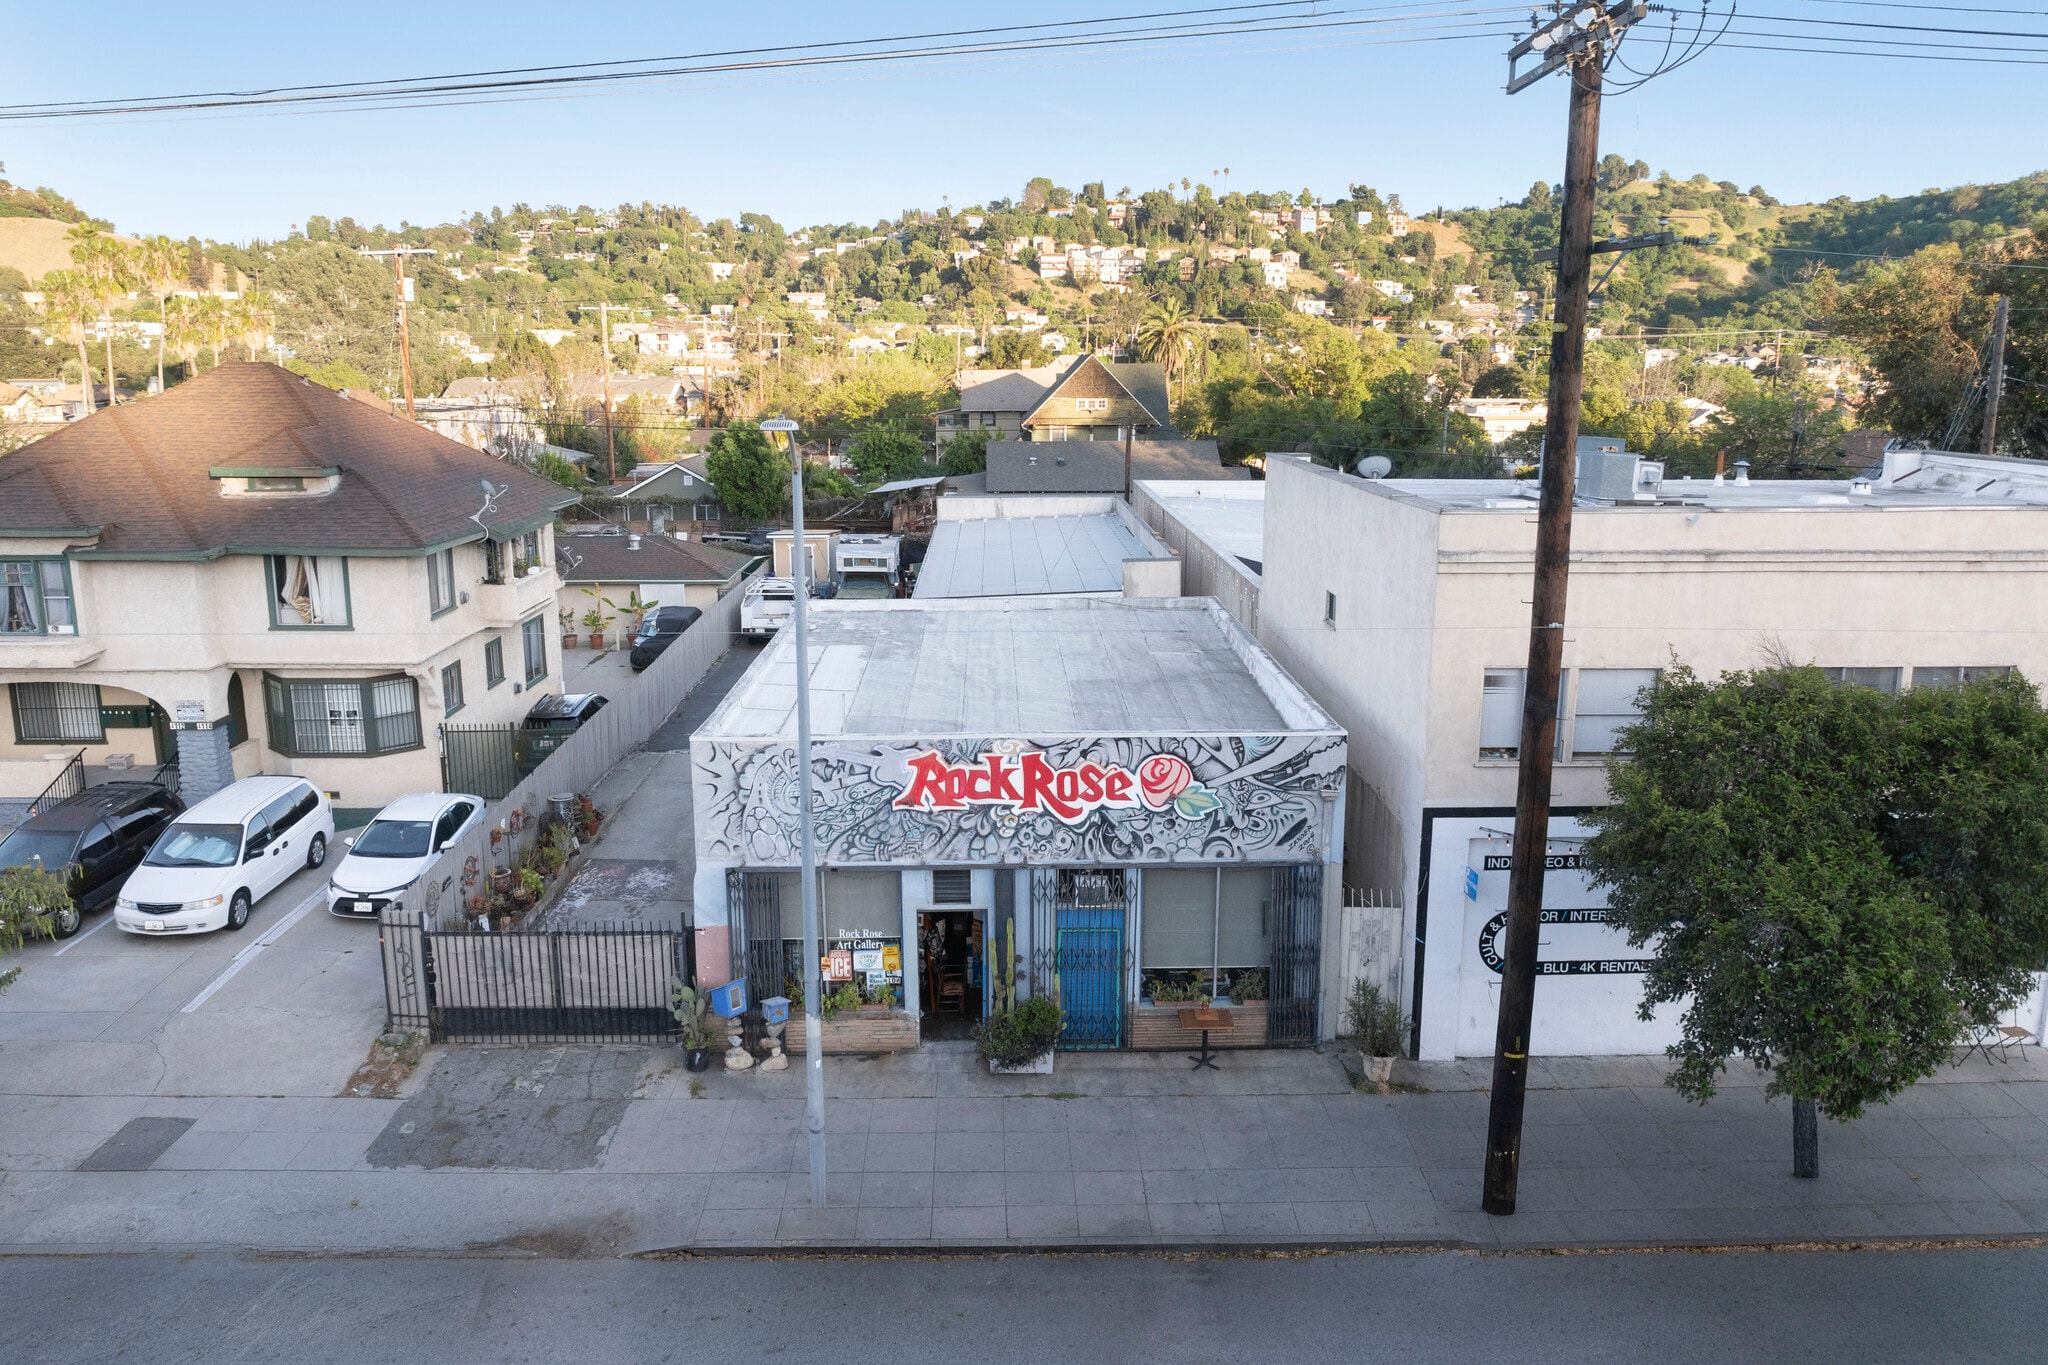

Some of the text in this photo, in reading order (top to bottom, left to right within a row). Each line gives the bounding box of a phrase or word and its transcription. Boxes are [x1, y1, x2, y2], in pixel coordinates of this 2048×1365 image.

[894, 752, 1132, 818] Rock Rose
[1567, 857, 1575, 867] &
[1489, 921, 1501, 932] &
[838, 928, 883, 939] Rock Rose
[836, 940, 885, 950] Art Gallery
[1482, 932, 1498, 965] CULT
[830, 957, 851, 978] ICE
[1543, 963, 1569, 973] BLU
[1579, 962, 1596, 972] 4K
[1600, 961, 1651, 972] RENTAL
